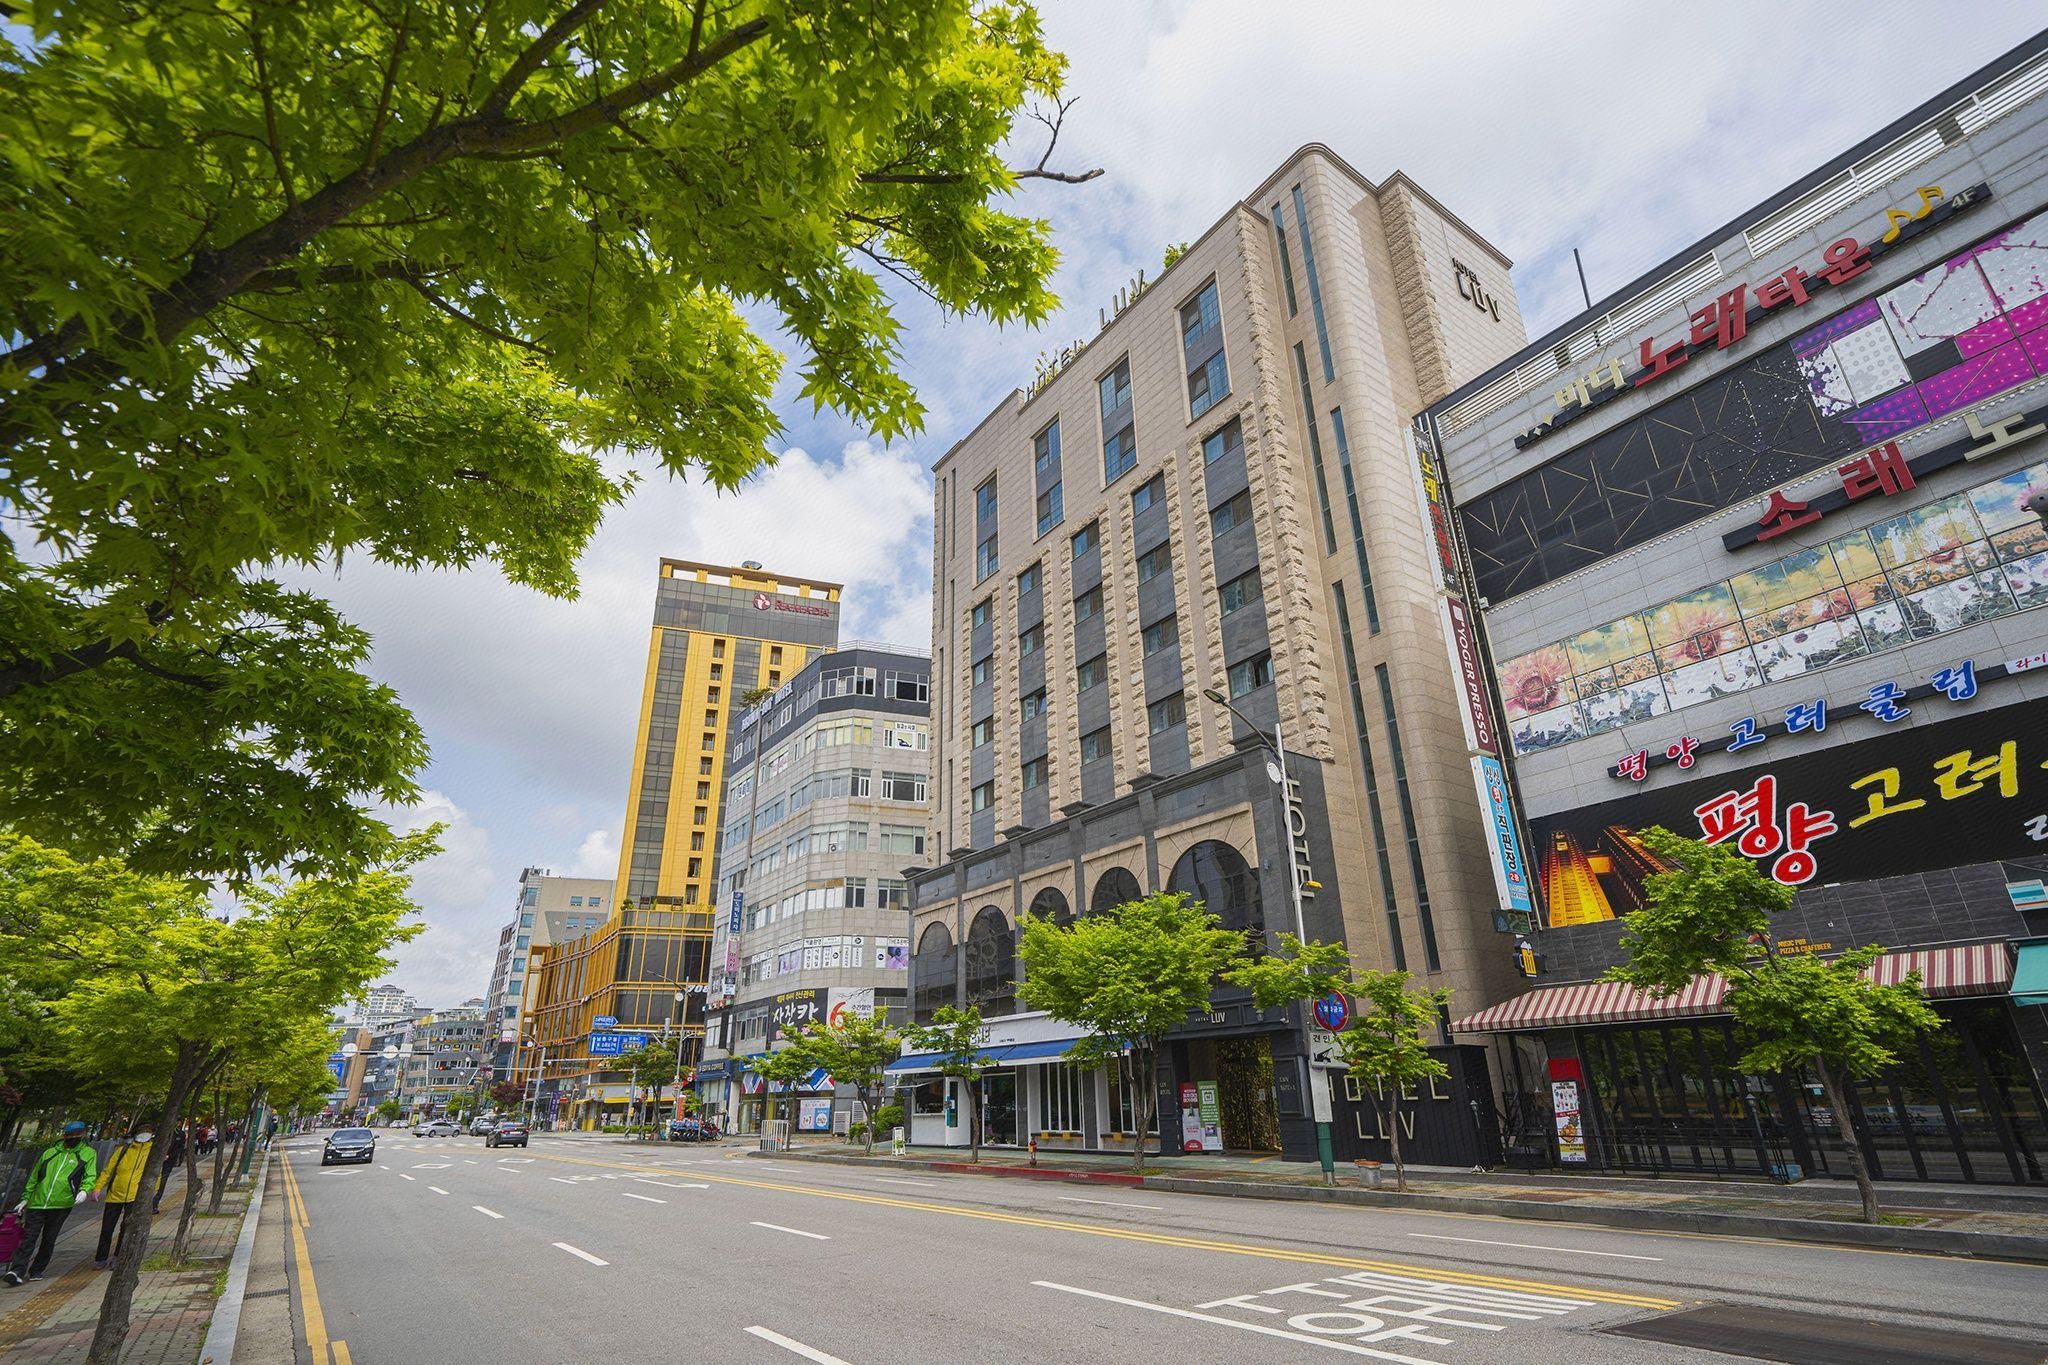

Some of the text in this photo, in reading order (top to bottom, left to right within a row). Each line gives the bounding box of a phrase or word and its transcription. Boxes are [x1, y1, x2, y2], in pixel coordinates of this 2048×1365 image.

[1099, 269, 1144, 330] LUV
[1451, 256, 1481, 287] HOTEL
[1553, 190, 1977, 411] 바다 노래타운 4F
[1457, 627, 1489, 744] YOGER PRESSO
[1617, 736, 1699, 781] 평양
[1860, 659, 1978, 723] 클럽
[1694, 774, 1837, 885] 평양
[1780, 947, 1795, 955] PIZZA
[1800, 943, 1832, 952] CRAFTBEER
[773, 1001, 819, 1026] 사잔카
[1211, 1011, 1225, 1024] LUV
